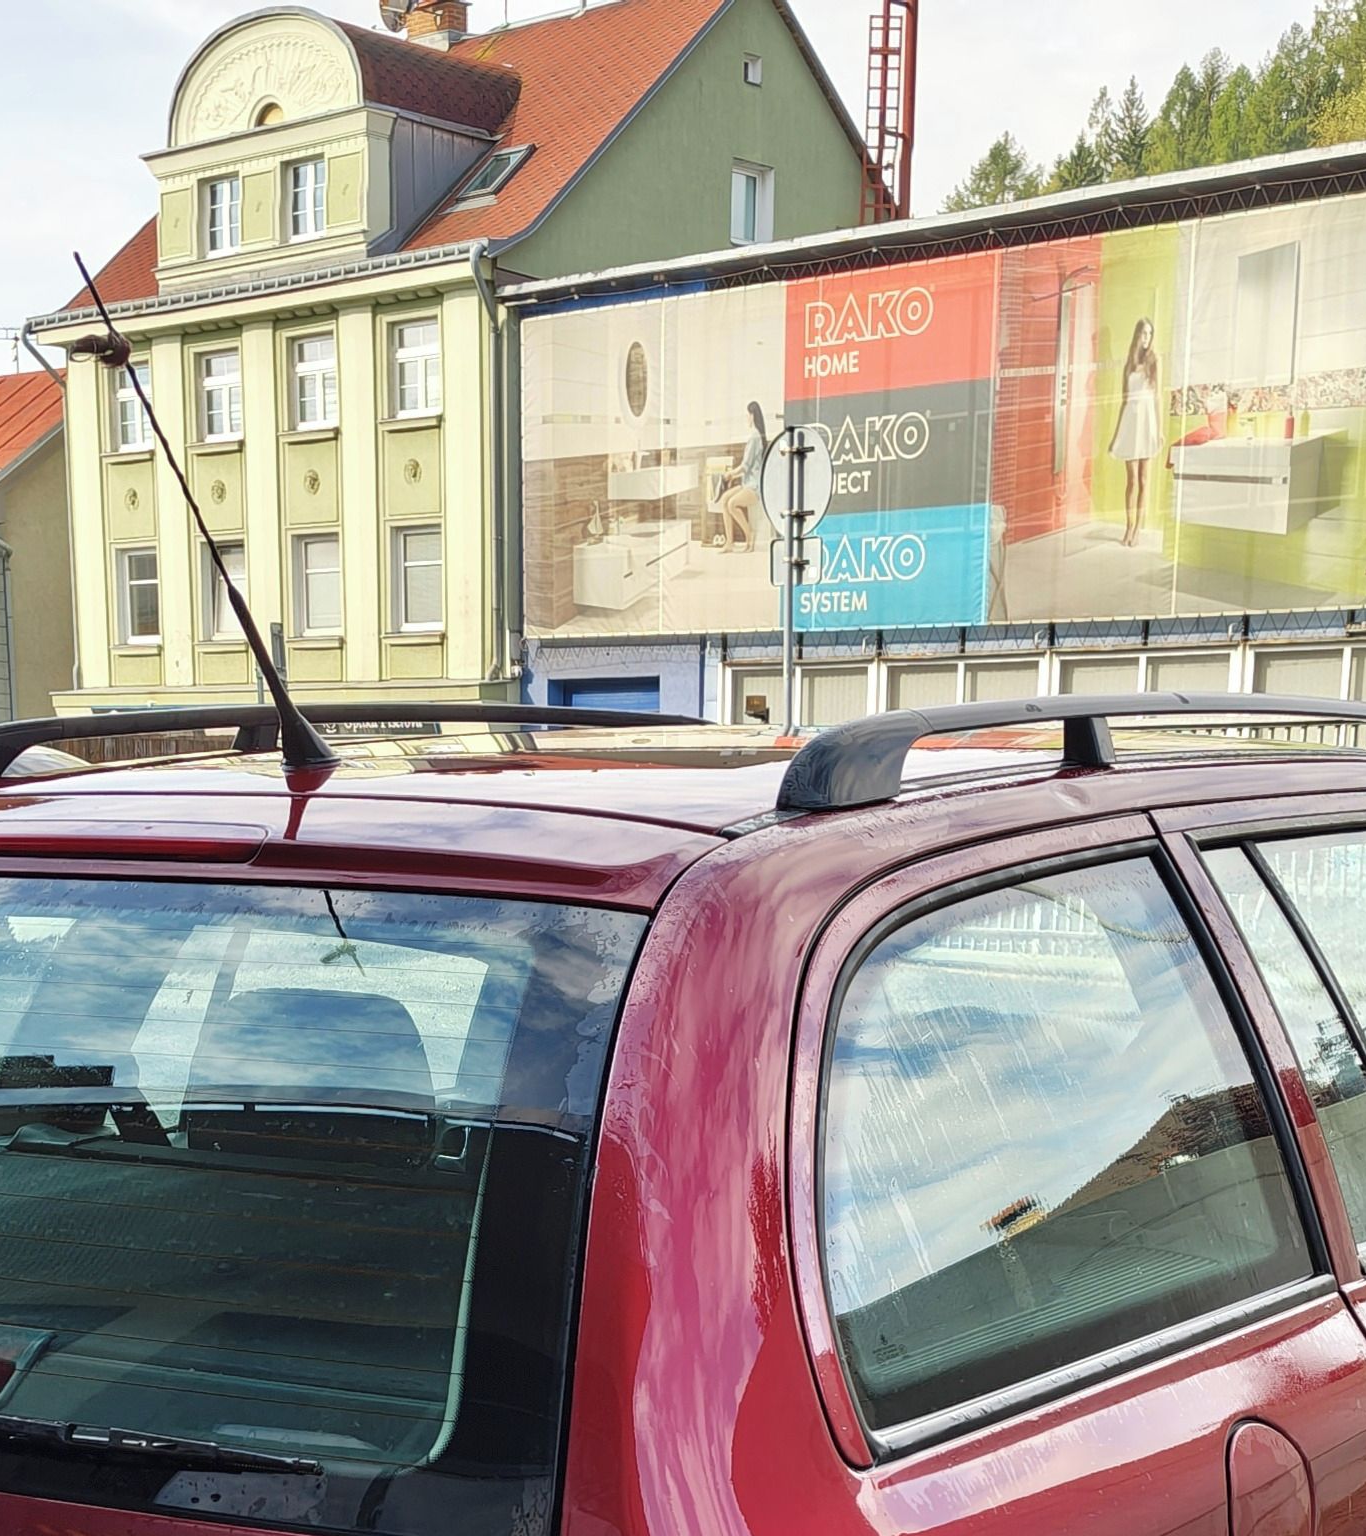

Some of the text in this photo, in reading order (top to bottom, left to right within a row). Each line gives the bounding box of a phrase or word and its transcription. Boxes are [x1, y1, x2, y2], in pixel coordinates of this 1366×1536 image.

[805, 286, 934, 349] RAKO
[804, 351, 860, 379] HOME
[820, 534, 926, 584] AKO
[800, 590, 868, 614] SYSTEM
